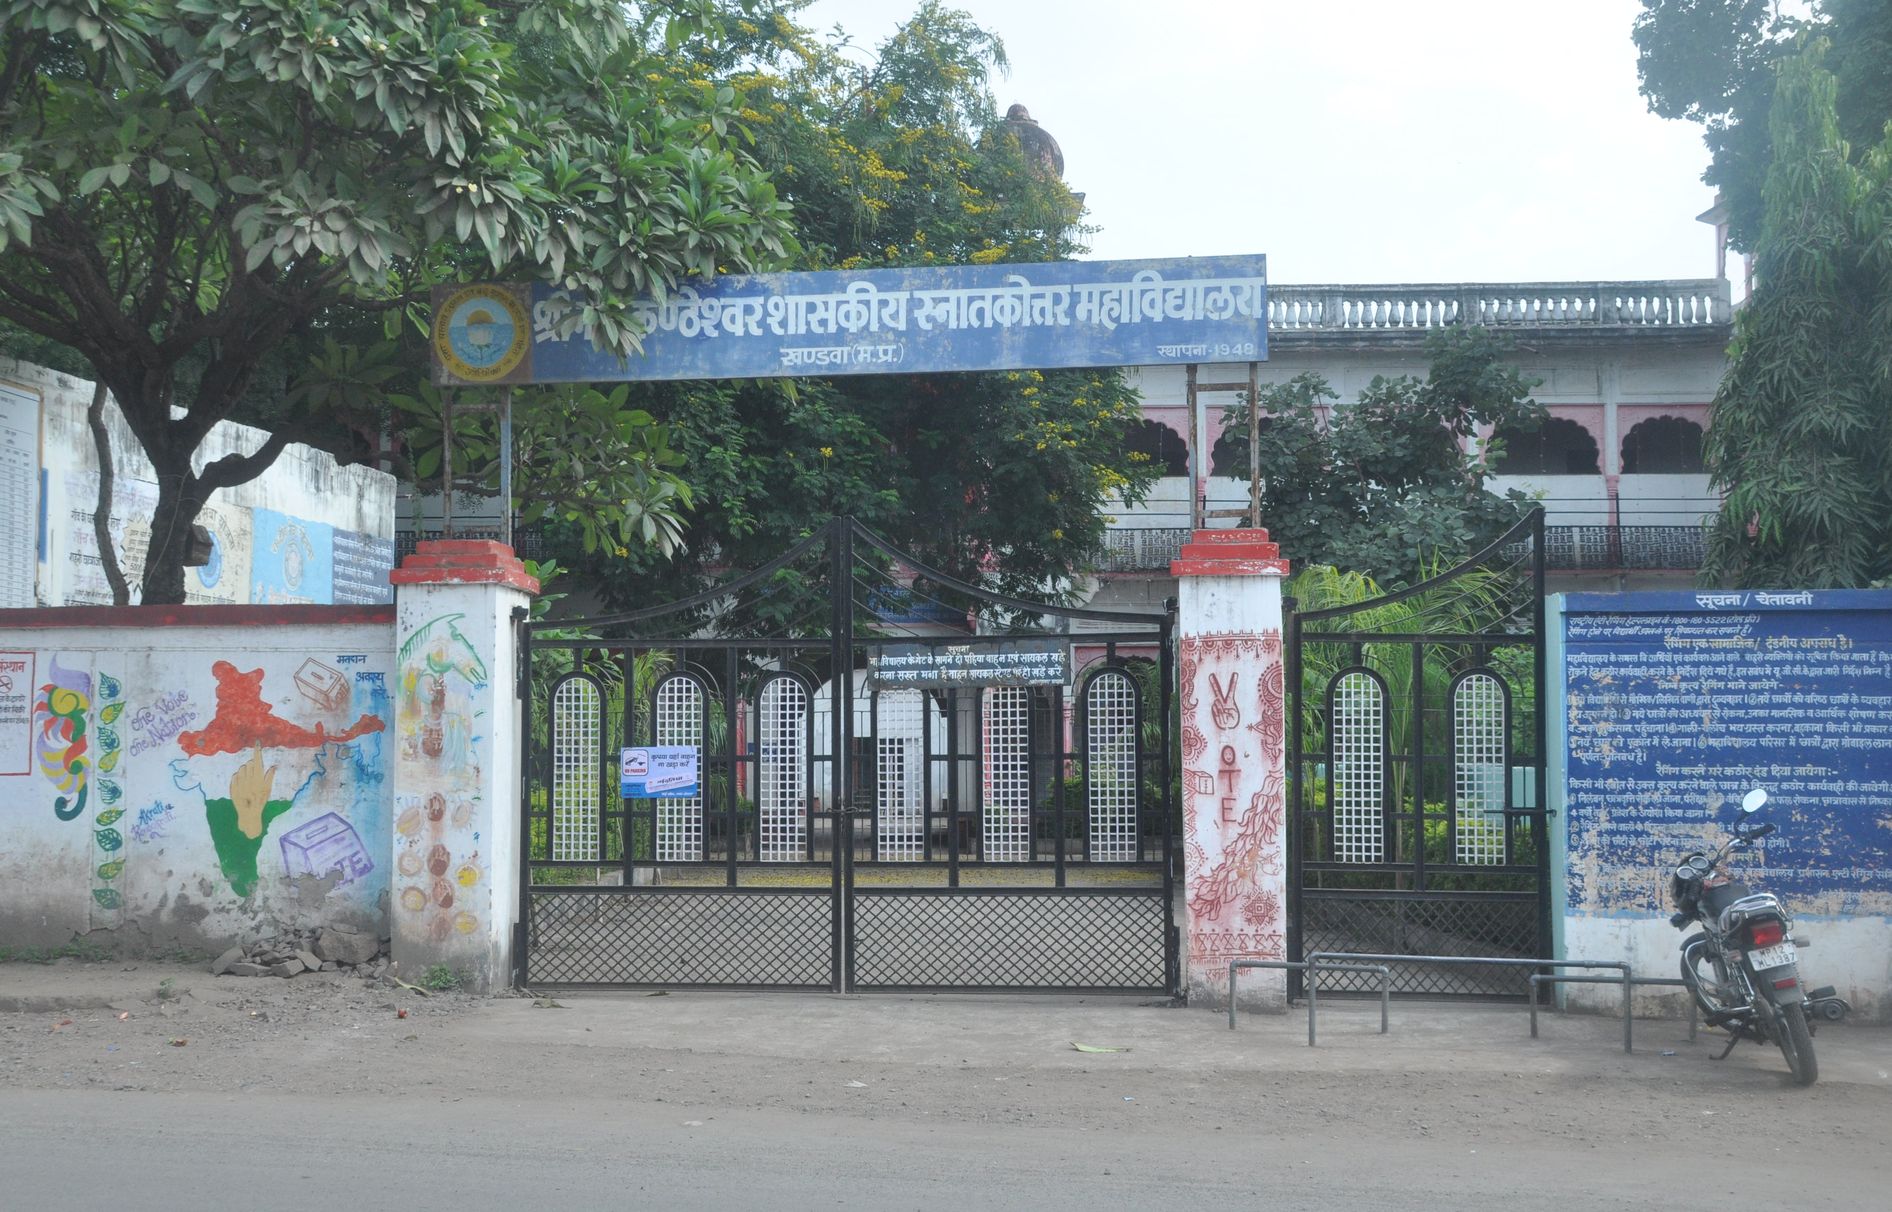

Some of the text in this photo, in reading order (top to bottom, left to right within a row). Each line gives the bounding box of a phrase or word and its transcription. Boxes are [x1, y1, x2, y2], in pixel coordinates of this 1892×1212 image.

[766, 280, 911, 337] शासकीय
[913, 275, 1073, 330] स्नातकोत्तर
[1073, 269, 1267, 331] महाविद्यालय
[780, 346, 851, 366] खण्डवा
[1695, 590, 1814, 610] सूचना चेतावनी
